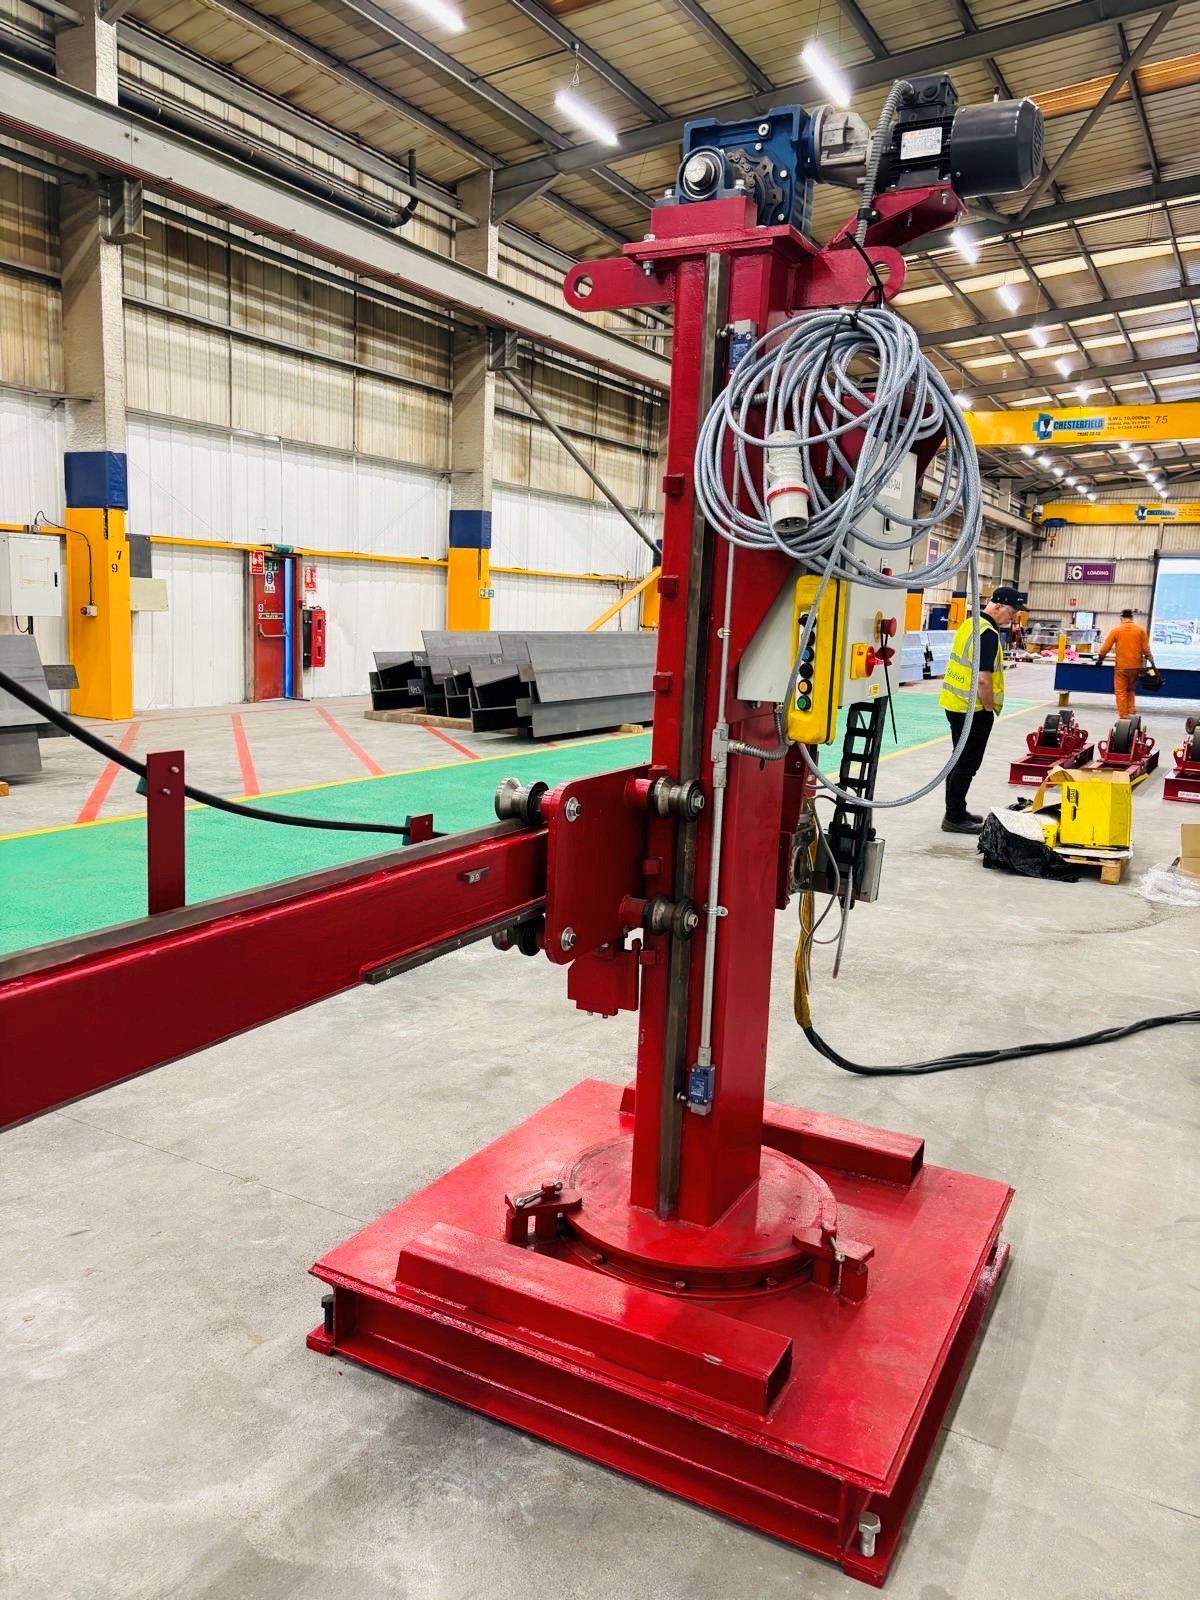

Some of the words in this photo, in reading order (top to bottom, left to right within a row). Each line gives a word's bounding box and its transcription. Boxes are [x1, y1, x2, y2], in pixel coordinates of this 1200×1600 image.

[1053, 418, 1104, 430] CHESTERFIELD
[116, 550, 122, 560] 7
[111, 563, 118, 573] 9
[1072, 565, 1083, 580] 6
